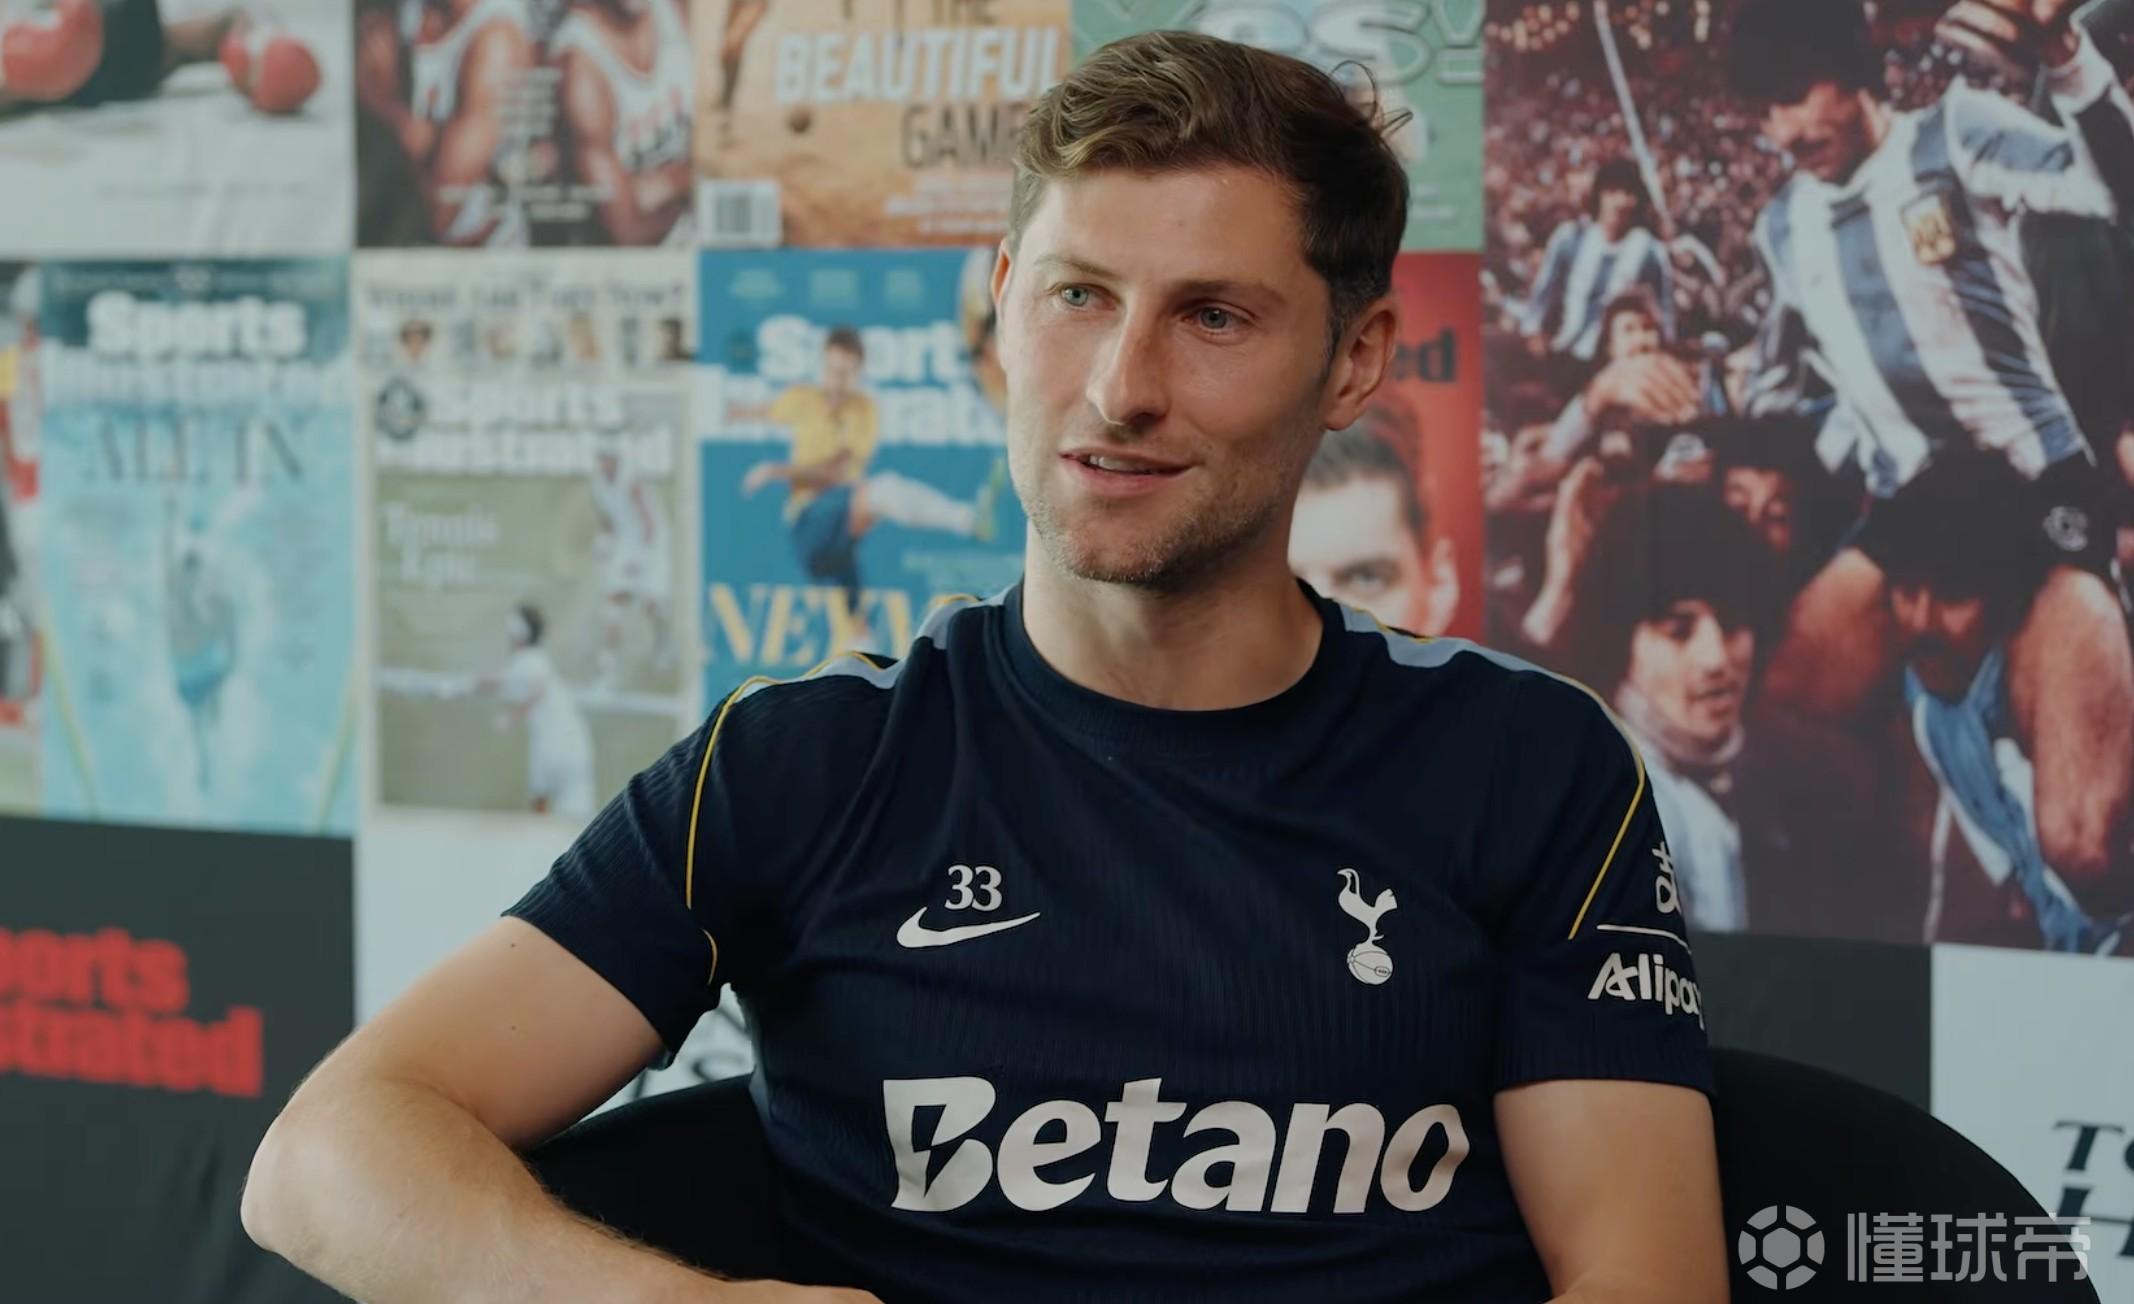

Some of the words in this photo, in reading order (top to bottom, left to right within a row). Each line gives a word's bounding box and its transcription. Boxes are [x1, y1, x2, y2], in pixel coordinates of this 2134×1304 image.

[86, 291, 307, 361] Sports
[944, 864, 1003, 912] 33
[883, 1076, 1470, 1214] Betano
